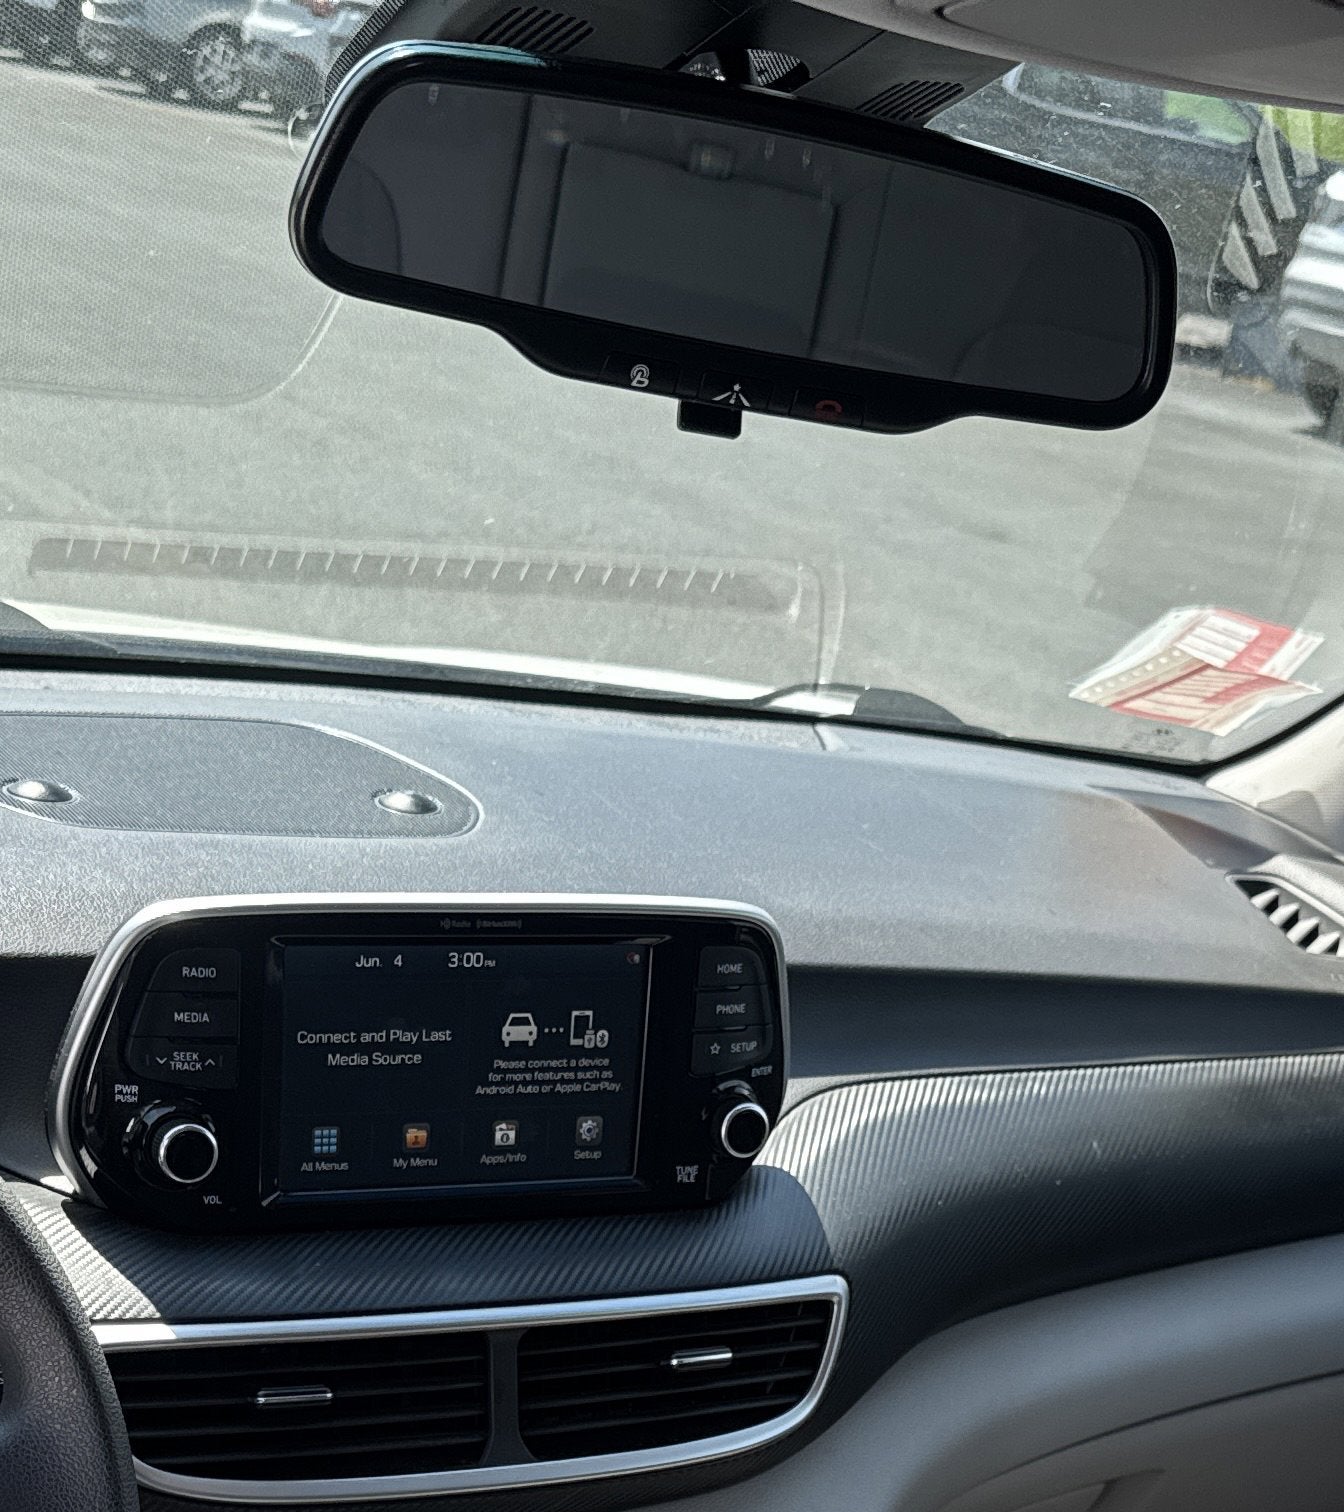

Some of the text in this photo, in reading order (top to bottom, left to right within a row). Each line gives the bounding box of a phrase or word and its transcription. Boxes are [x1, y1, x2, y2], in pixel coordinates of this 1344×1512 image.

[355, 954, 403, 968] Jun. 4
[182, 966, 217, 978] RADIO
[717, 963, 743, 975] HOME
[716, 1003, 746, 1015] PHONE
[174, 1011, 210, 1023] MEDIA
[297, 1029, 453, 1045] Connect and Play Last
[730, 1041, 757, 1053] SETUP
[173, 1051, 199, 1061] SEEK
[327, 1052, 423, 1067] Media Source
[170, 1060, 203, 1072] TRACK
[493, 1057, 610, 1070] Please connect a device
[488, 1069, 613, 1082] for more features such as
[751, 1065, 773, 1077] ENTER
[115, 1084, 138, 1094] PWR
[475, 1084, 514, 1095] Android
[515, 1083, 541, 1094] Auto
[541, 1084, 554, 1093] or
[555, 1082, 582, 1094] Apple
[480, 1152, 527, 1165] Apps/Info
[573, 1149, 602, 1161] Setup
[301, 1161, 349, 1172] All Menus
[393, 1156, 438, 1169] My Menu
[676, 1164, 698, 1175] TUNE
[677, 1173, 695, 1183] FILE
[203, 1195, 222, 1205] VOL
